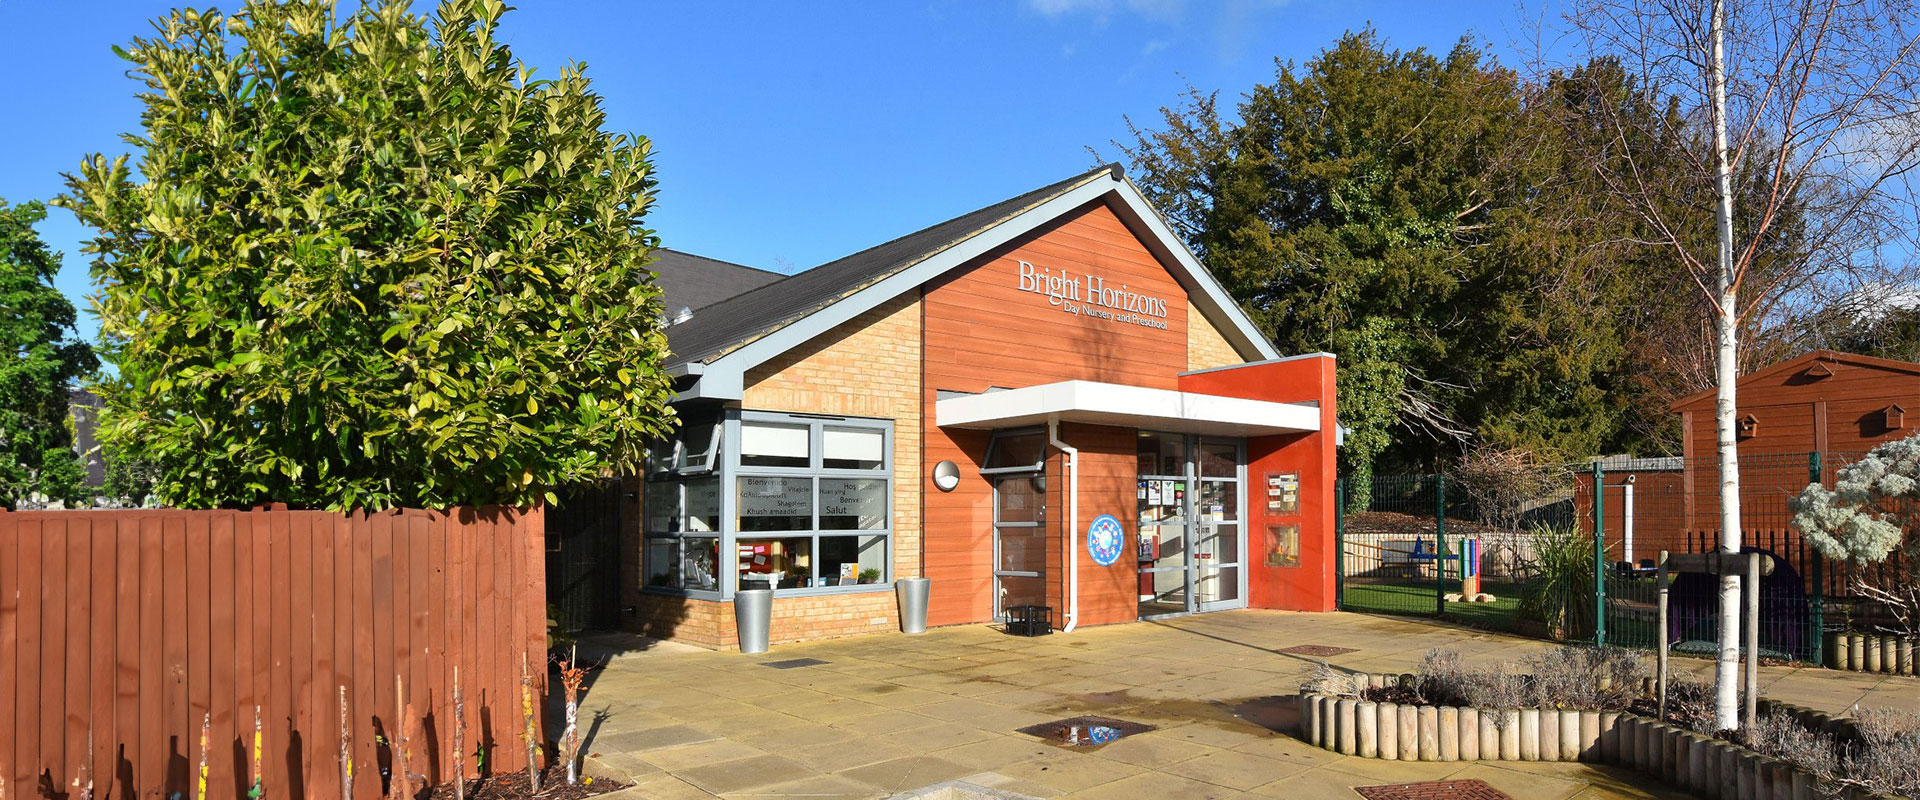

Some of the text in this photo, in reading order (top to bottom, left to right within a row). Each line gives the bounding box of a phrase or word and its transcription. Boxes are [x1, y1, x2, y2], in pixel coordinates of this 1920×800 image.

[1017, 260, 1167, 318] Bright Horizons
[1064, 301, 1168, 330] Day Nursery and Preschool
[826, 505, 847, 514] Salut
